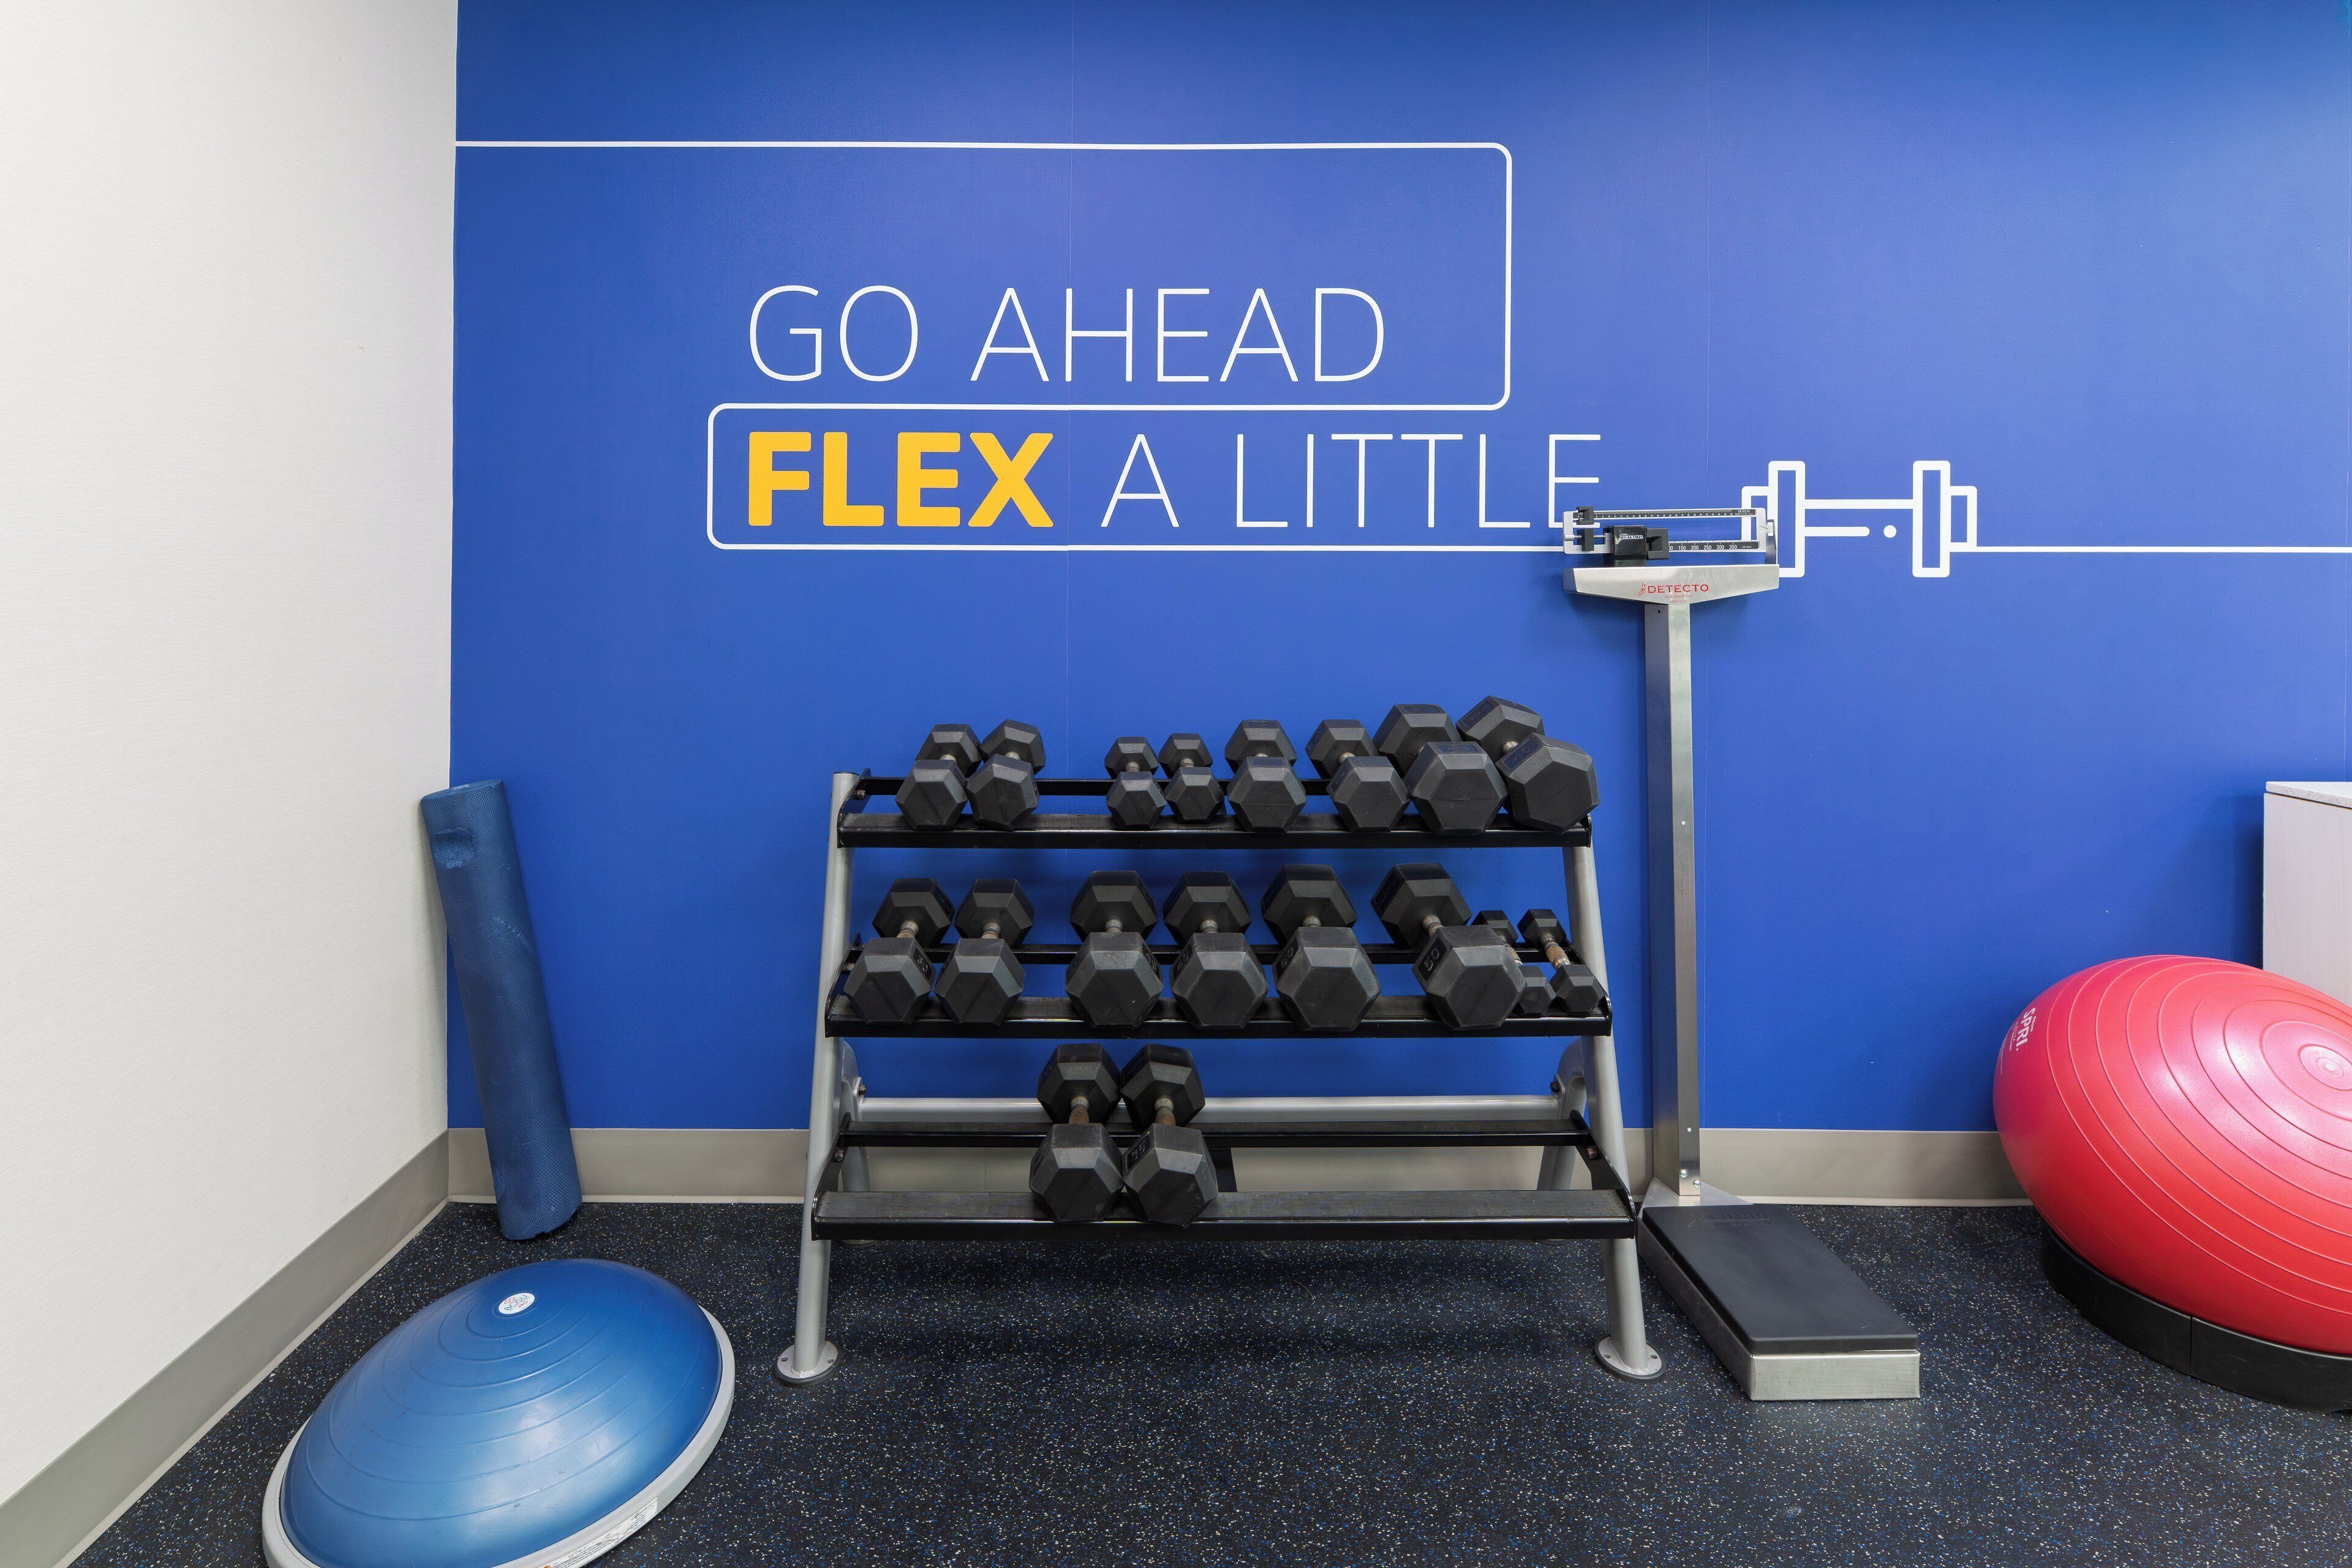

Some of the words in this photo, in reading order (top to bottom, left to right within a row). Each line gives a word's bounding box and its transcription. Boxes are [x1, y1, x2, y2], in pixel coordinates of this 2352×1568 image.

[749, 284, 919, 383] GO
[970, 287, 1384, 383] AHEAD
[748, 431, 1054, 527] FLEX
[1100, 432, 1180, 528] A
[1235, 432, 1602, 529] LITTLE
[1648, 584, 1709, 594] DETECTO
[1424, 948, 1439, 971] 50
[503, 1294, 528, 1311] BOSU
